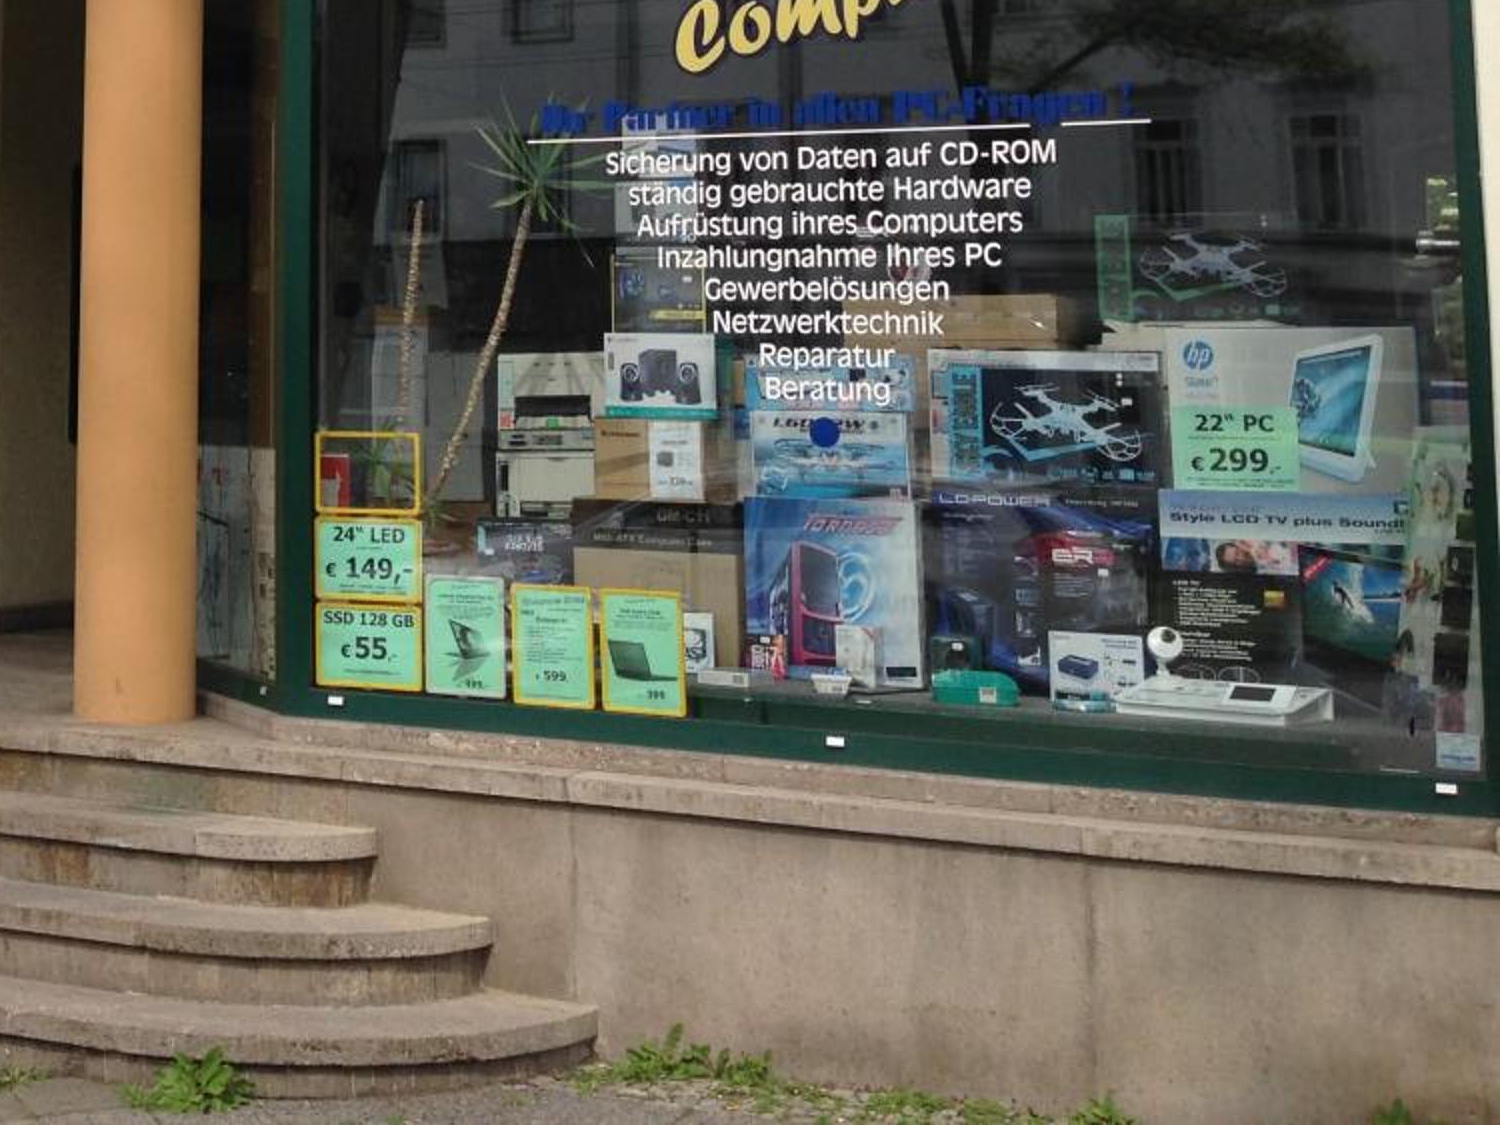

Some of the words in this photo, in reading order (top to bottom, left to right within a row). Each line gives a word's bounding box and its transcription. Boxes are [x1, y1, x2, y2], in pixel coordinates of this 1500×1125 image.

[605, 150, 731, 176] Sicherung
[739, 150, 788, 172] von
[798, 145, 877, 170] Daten
[885, 141, 932, 168] auf
[940, 139, 1057, 166] CD-ROM
[629, 180, 721, 208] ständig
[729, 177, 885, 207] gebrauchte
[894, 175, 1032, 201] Hardware
[637, 212, 783, 240] Aufrüstung
[792, 210, 857, 235] ihres
[867, 208, 1023, 238] Computers
[658, 244, 877, 272] Inzahlungnahme
[887, 242, 955, 268] Ihres
[965, 242, 1002, 267] PC
[705, 276, 950, 305] Gewerbelösungen
[712, 310, 944, 335] Netzwerktechnik
[758, 343, 896, 370] Reparatur
[1185, 341, 1211, 370] hp
[764, 376, 891, 406] Beratung
[1243, 414, 1274, 432] PC
[1170, 512, 1215, 524] Style
[1221, 514, 1259, 524] LCD
[1266, 516, 1287, 525] TV
[1294, 516, 1332, 527] plus
[371, 527, 405, 544] LED
[323, 610, 355, 624] SSD
[360, 613, 387, 626] 128
[392, 614, 414, 628] GB
